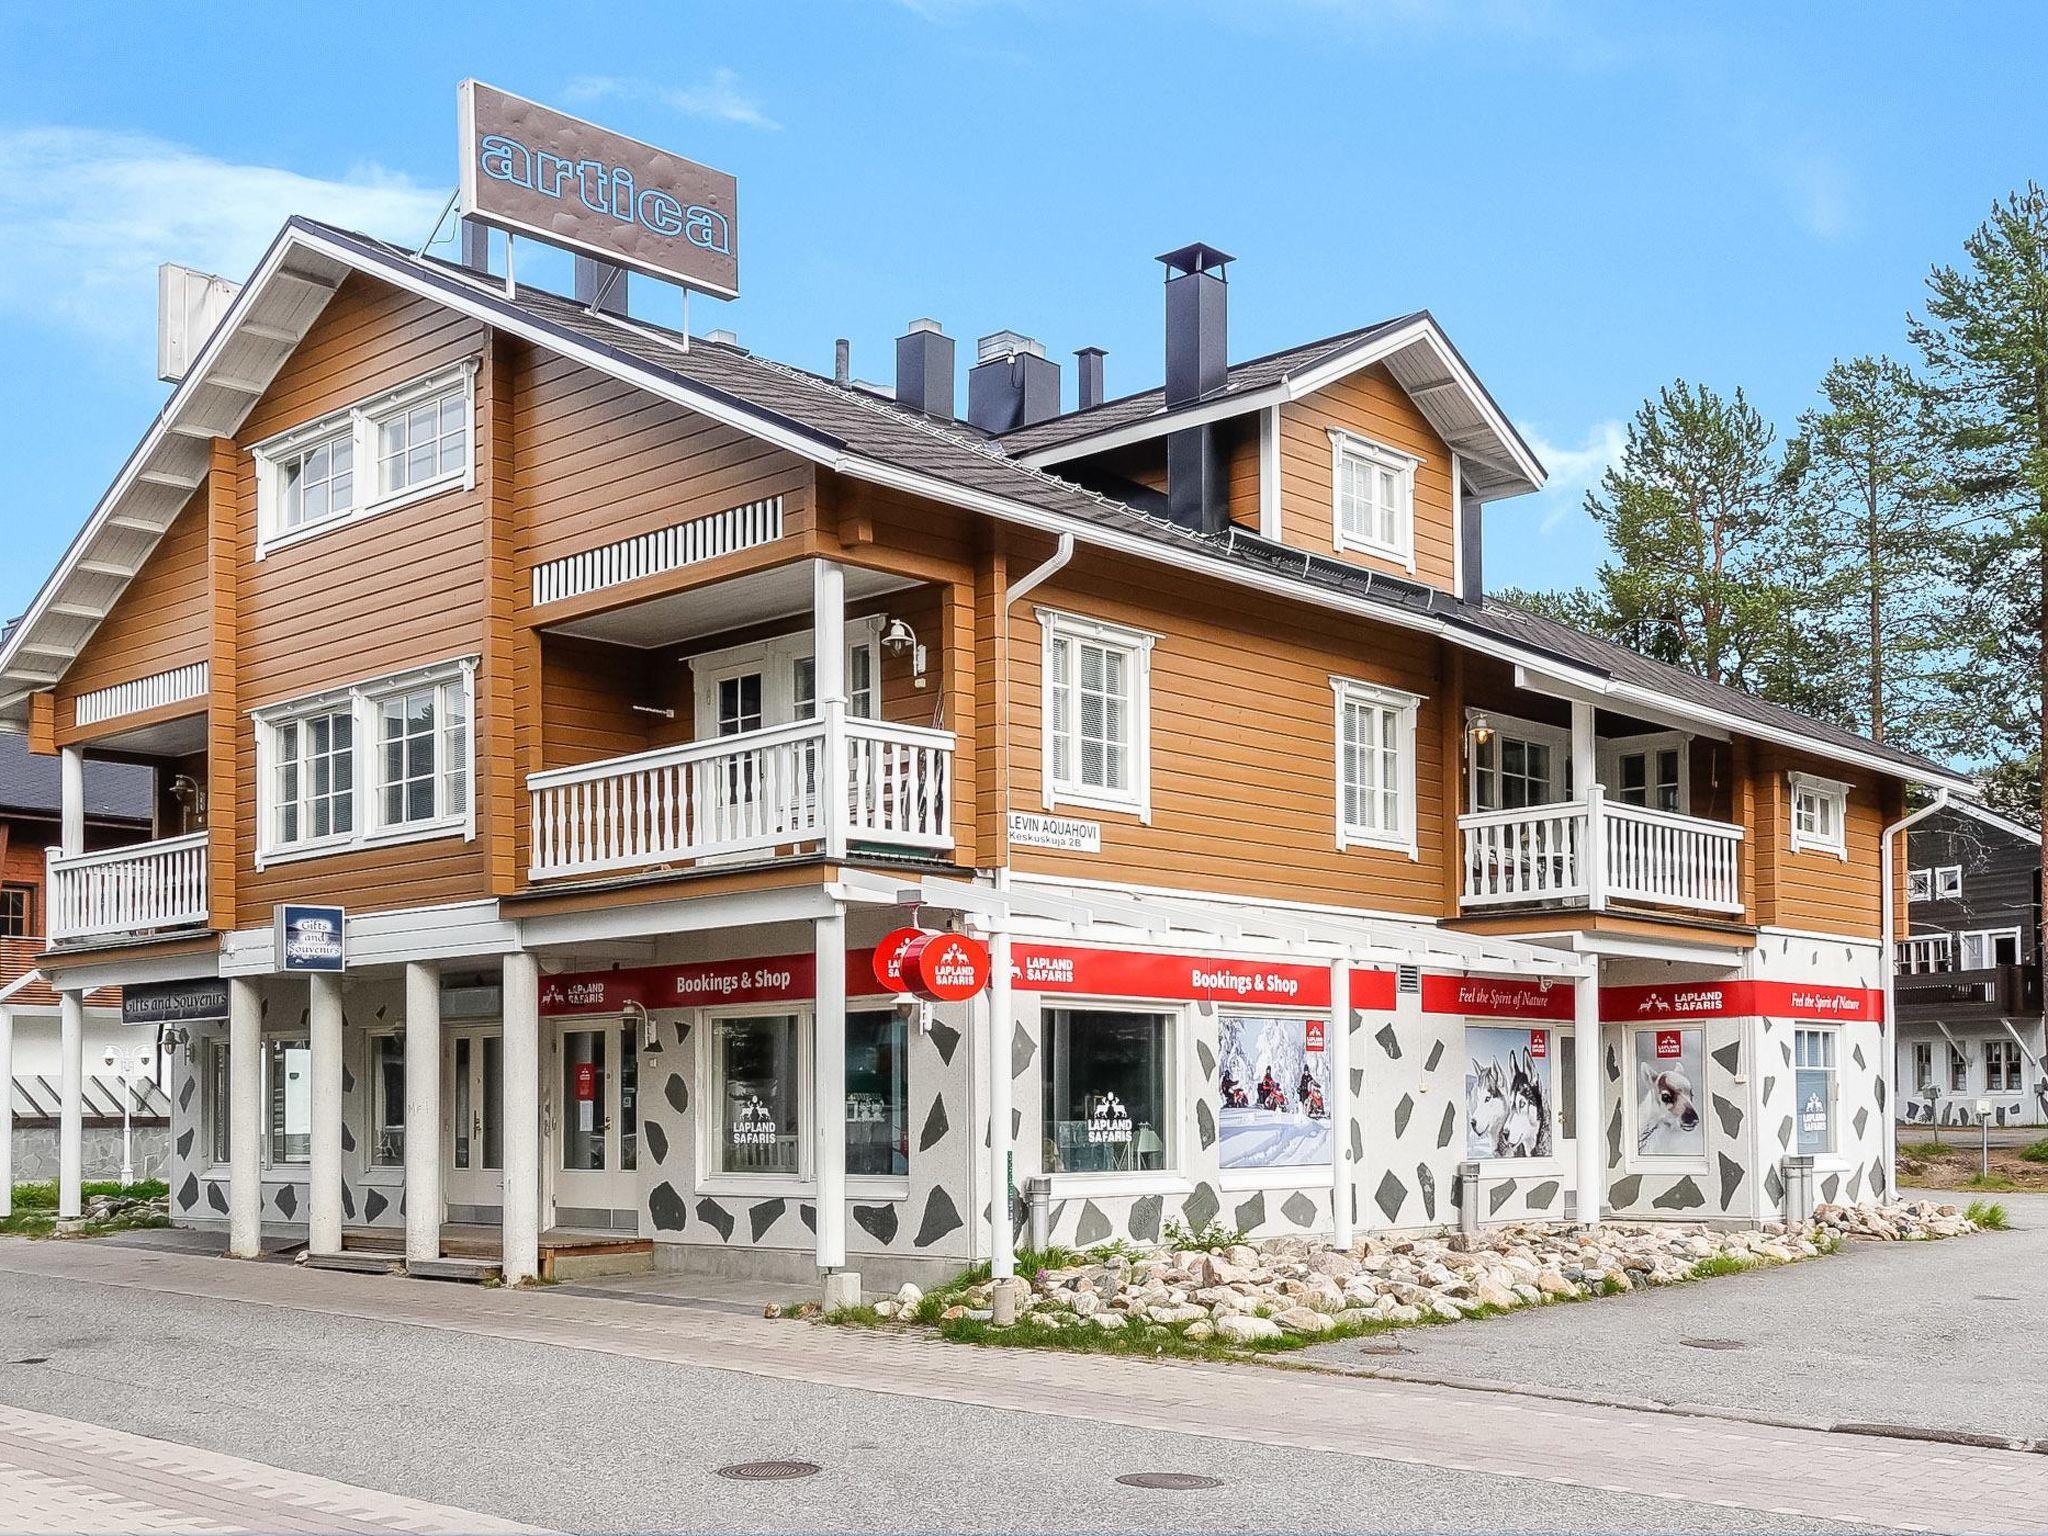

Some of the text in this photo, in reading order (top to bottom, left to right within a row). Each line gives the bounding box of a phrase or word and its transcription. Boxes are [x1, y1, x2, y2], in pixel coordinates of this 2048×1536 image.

[481, 134, 730, 255] artica
[1009, 815, 1096, 839] LEVIN AQUAHOVI
[1009, 831, 1066, 847] Keskuskuja
[301, 920, 327, 931] Gifts
[304, 932, 325, 942] and
[1026, 956, 1073, 971] LAPLAND
[935, 965, 975, 976] LAPLAND
[1026, 968, 1073, 983] SAFARIS
[676, 969, 791, 994] Bookings & Shop
[935, 975, 975, 986] SAFARIS
[1192, 969, 1298, 996] Bookings & Shop
[567, 983, 604, 995] LAPLAND
[124, 992, 228, 1012] Gifts and Souvenirs
[1459, 987, 1548, 1010] Feel the Spirit of Nature
[1674, 991, 1723, 1002] LAPLAND
[1791, 992, 1859, 1013] Feel the Spirit of Nature
[1674, 1000, 1723, 1011] SAFARIS
[733, 1122, 776, 1133] LAPLAND
[1087, 1119, 1133, 1131] LAPLAND
[733, 1132, 776, 1144] SAFARIS
[1087, 1130, 1133, 1143] SAFARIS
